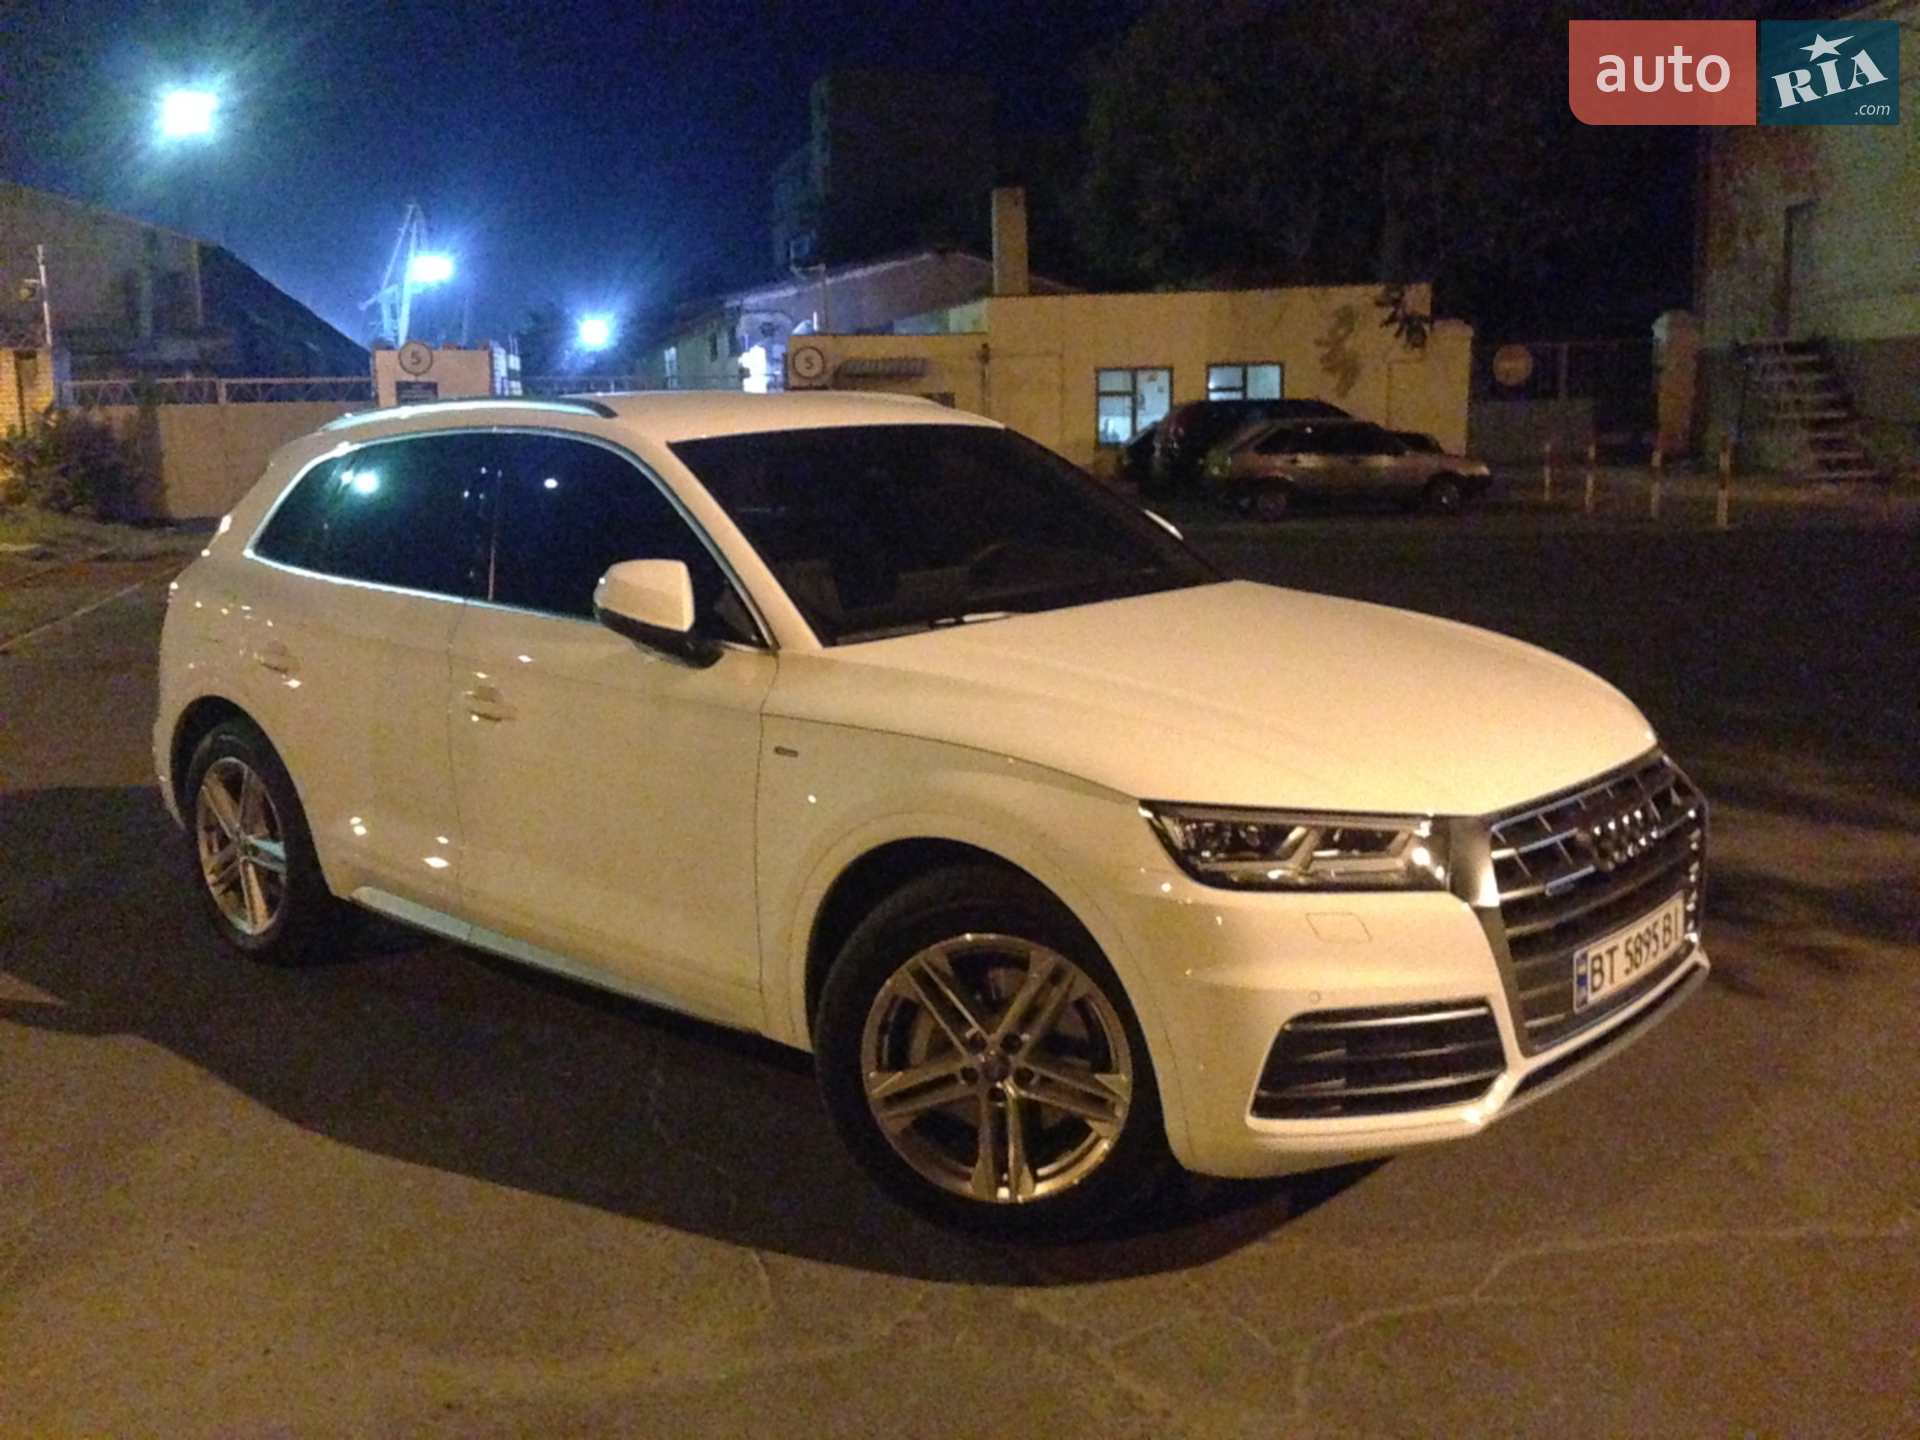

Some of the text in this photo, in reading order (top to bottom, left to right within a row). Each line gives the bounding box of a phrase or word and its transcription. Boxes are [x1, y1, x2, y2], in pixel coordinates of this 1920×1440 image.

[411, 351, 421, 365] 5
[1591, 906, 1679, 993] BT 5895 BI
